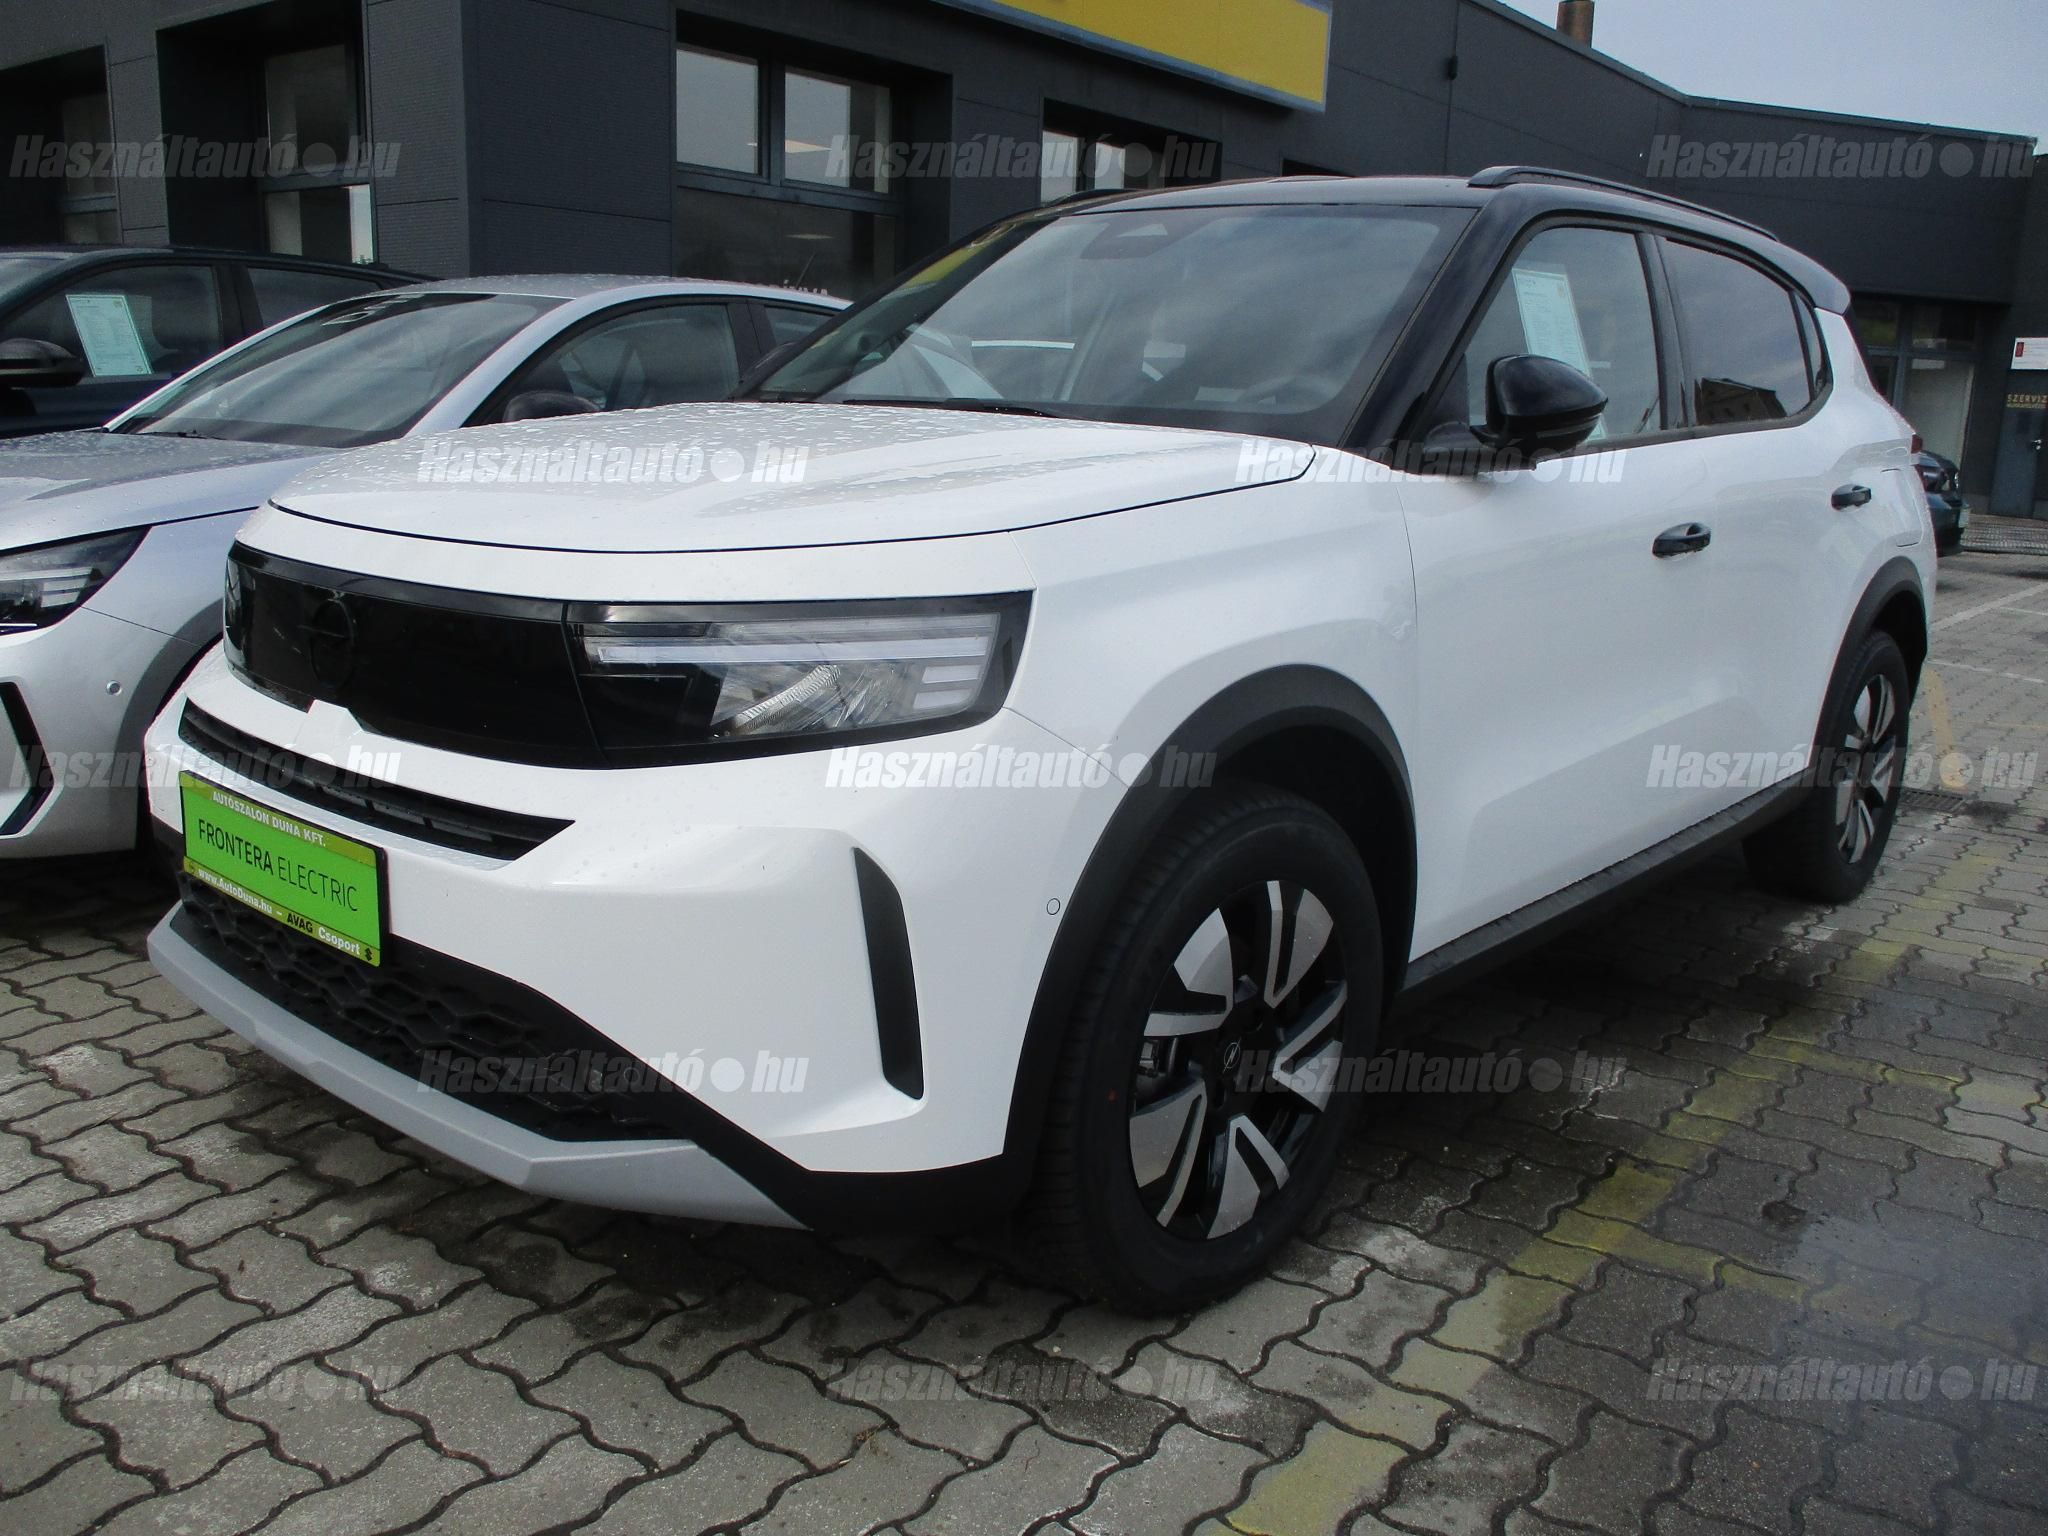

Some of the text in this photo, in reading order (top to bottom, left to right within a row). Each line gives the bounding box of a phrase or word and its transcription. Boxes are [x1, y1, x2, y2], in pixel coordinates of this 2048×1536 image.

[272, 816, 301, 838] DUNA
[303, 828, 326, 847] KFT.
[198, 818, 359, 912] FRONTERA ELECTRIC
[286, 912, 314, 933] AVAG
[318, 926, 361, 956] Csoport
